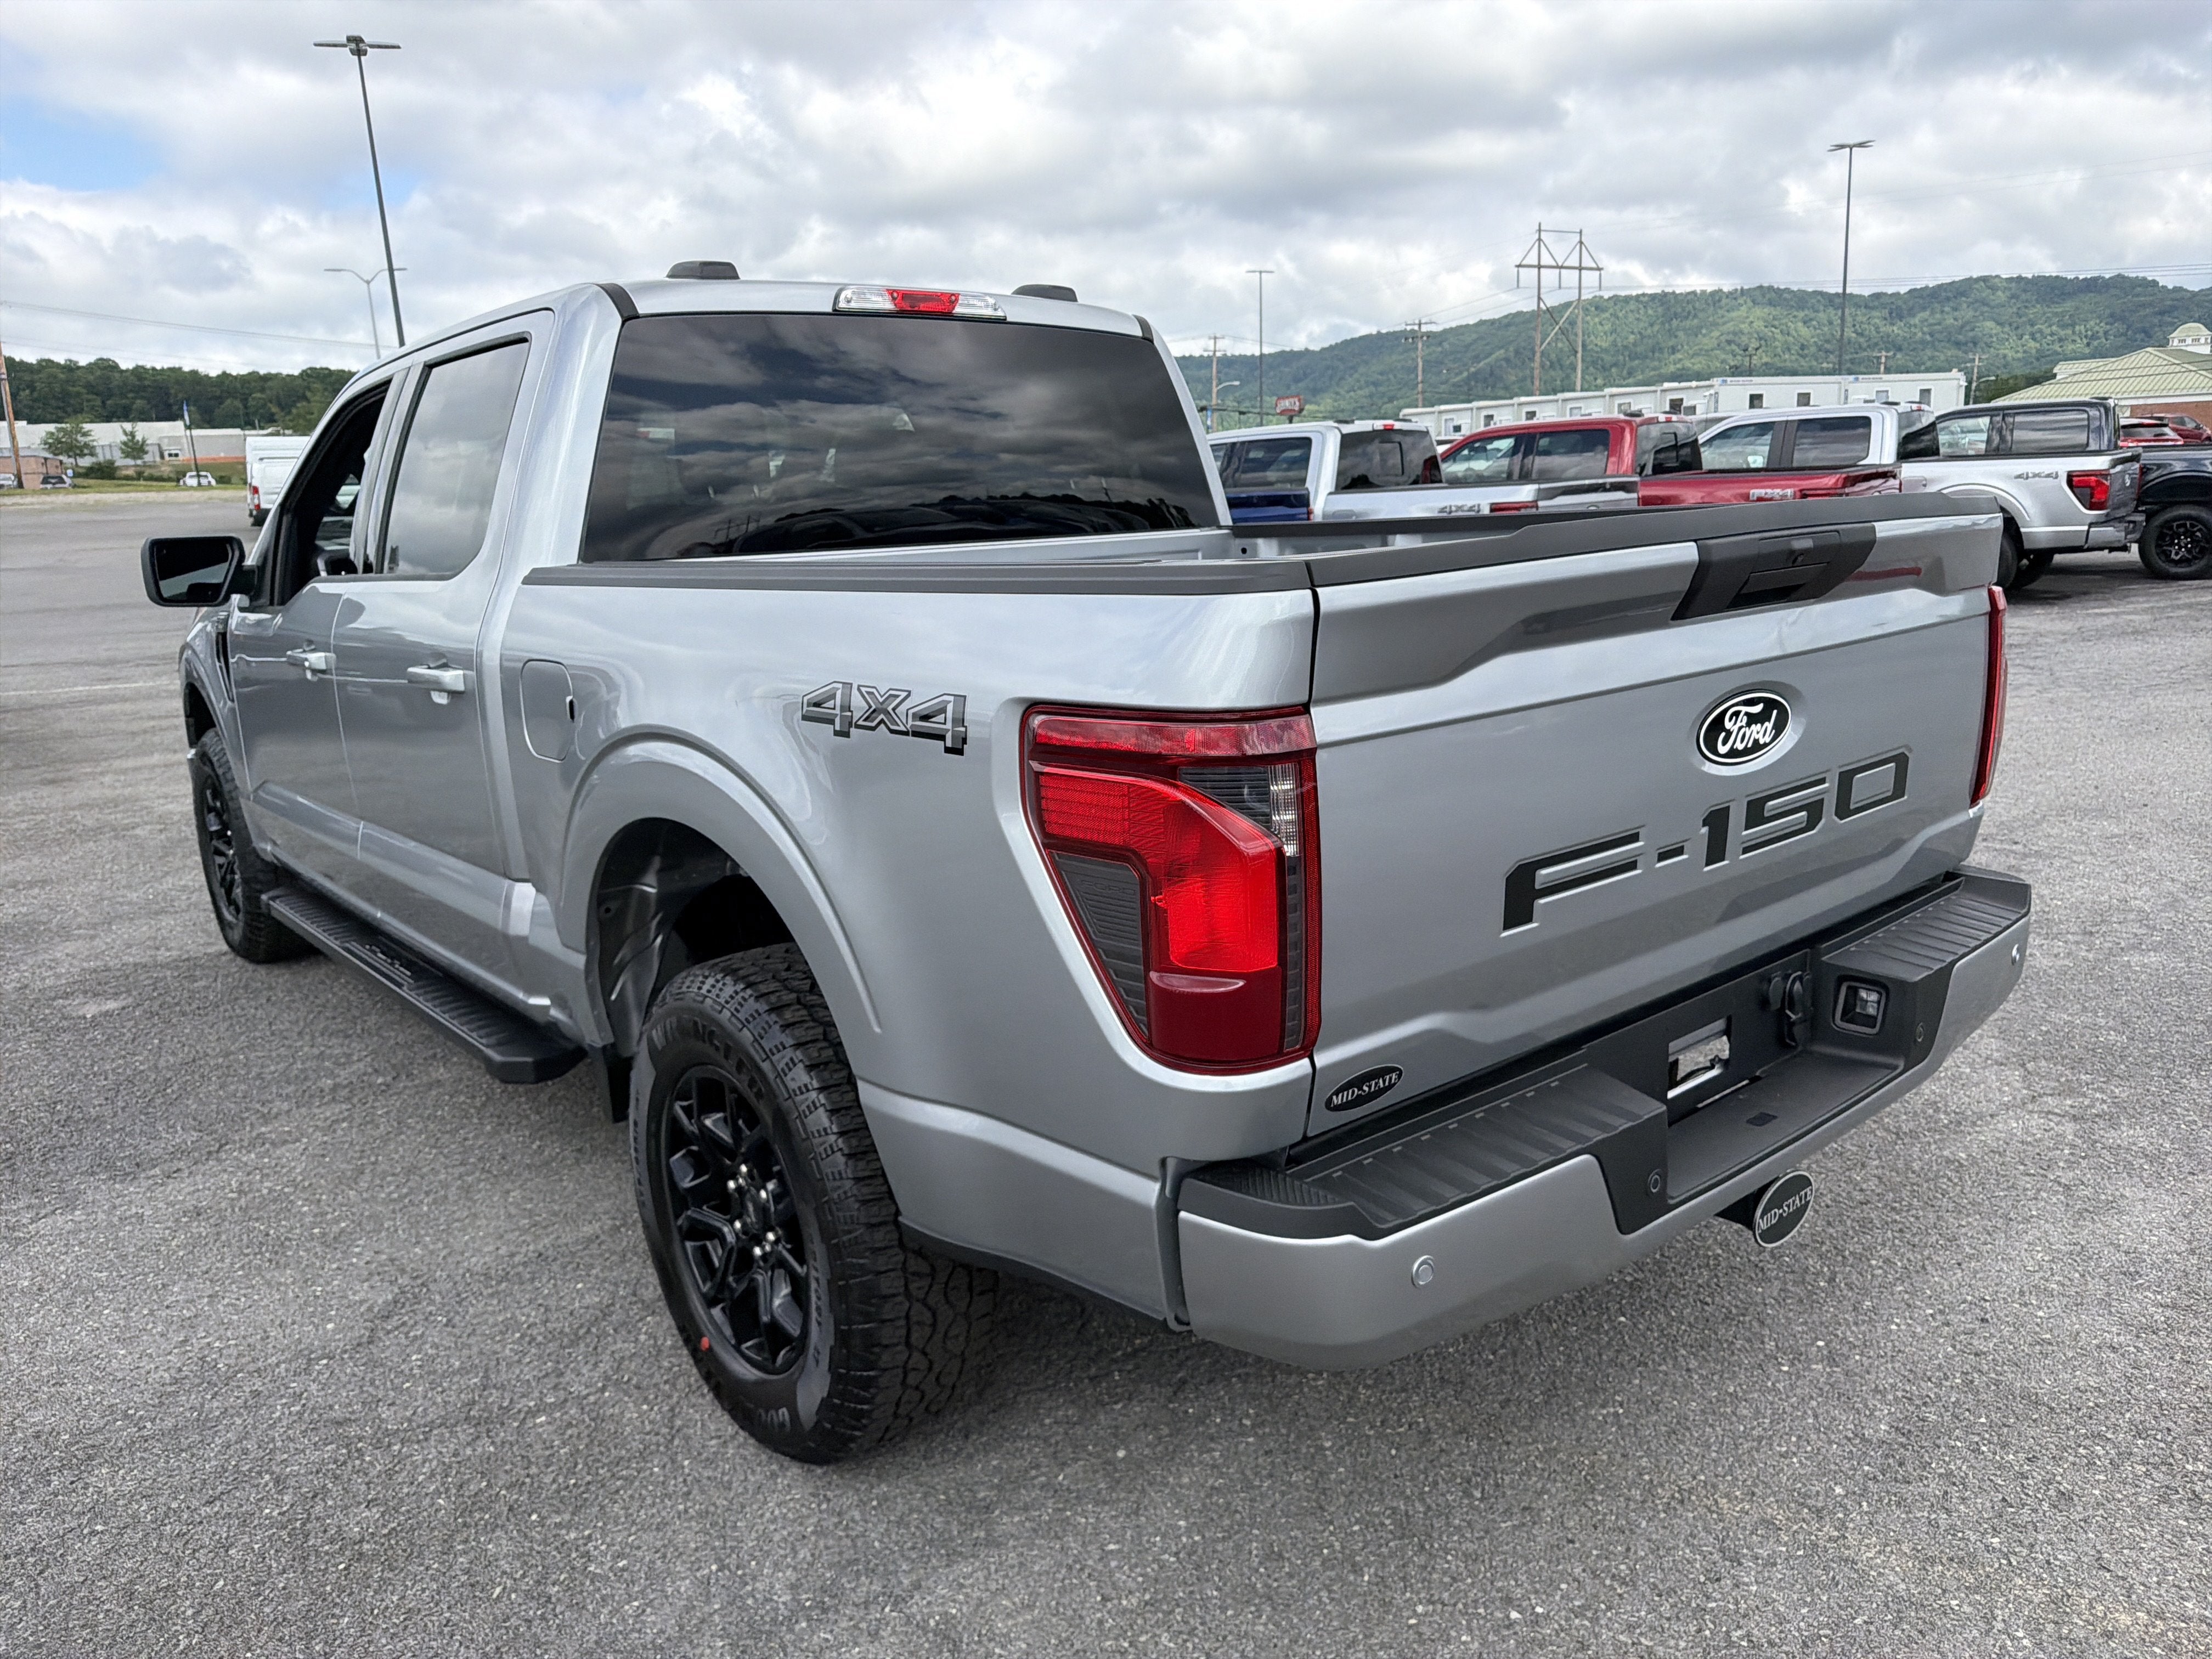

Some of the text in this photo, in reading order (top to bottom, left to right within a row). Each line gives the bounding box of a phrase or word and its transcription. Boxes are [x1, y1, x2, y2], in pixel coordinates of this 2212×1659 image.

[801, 680, 967, 756] 4X4
[1717, 703, 1778, 754] Ford
[1500, 748, 1910, 935] F-150
[651, 1015, 768, 1110] WRNGLER
[1330, 1071, 1400, 1108] MID-STATE
[1758, 1186, 1812, 1233] MID-STATE
